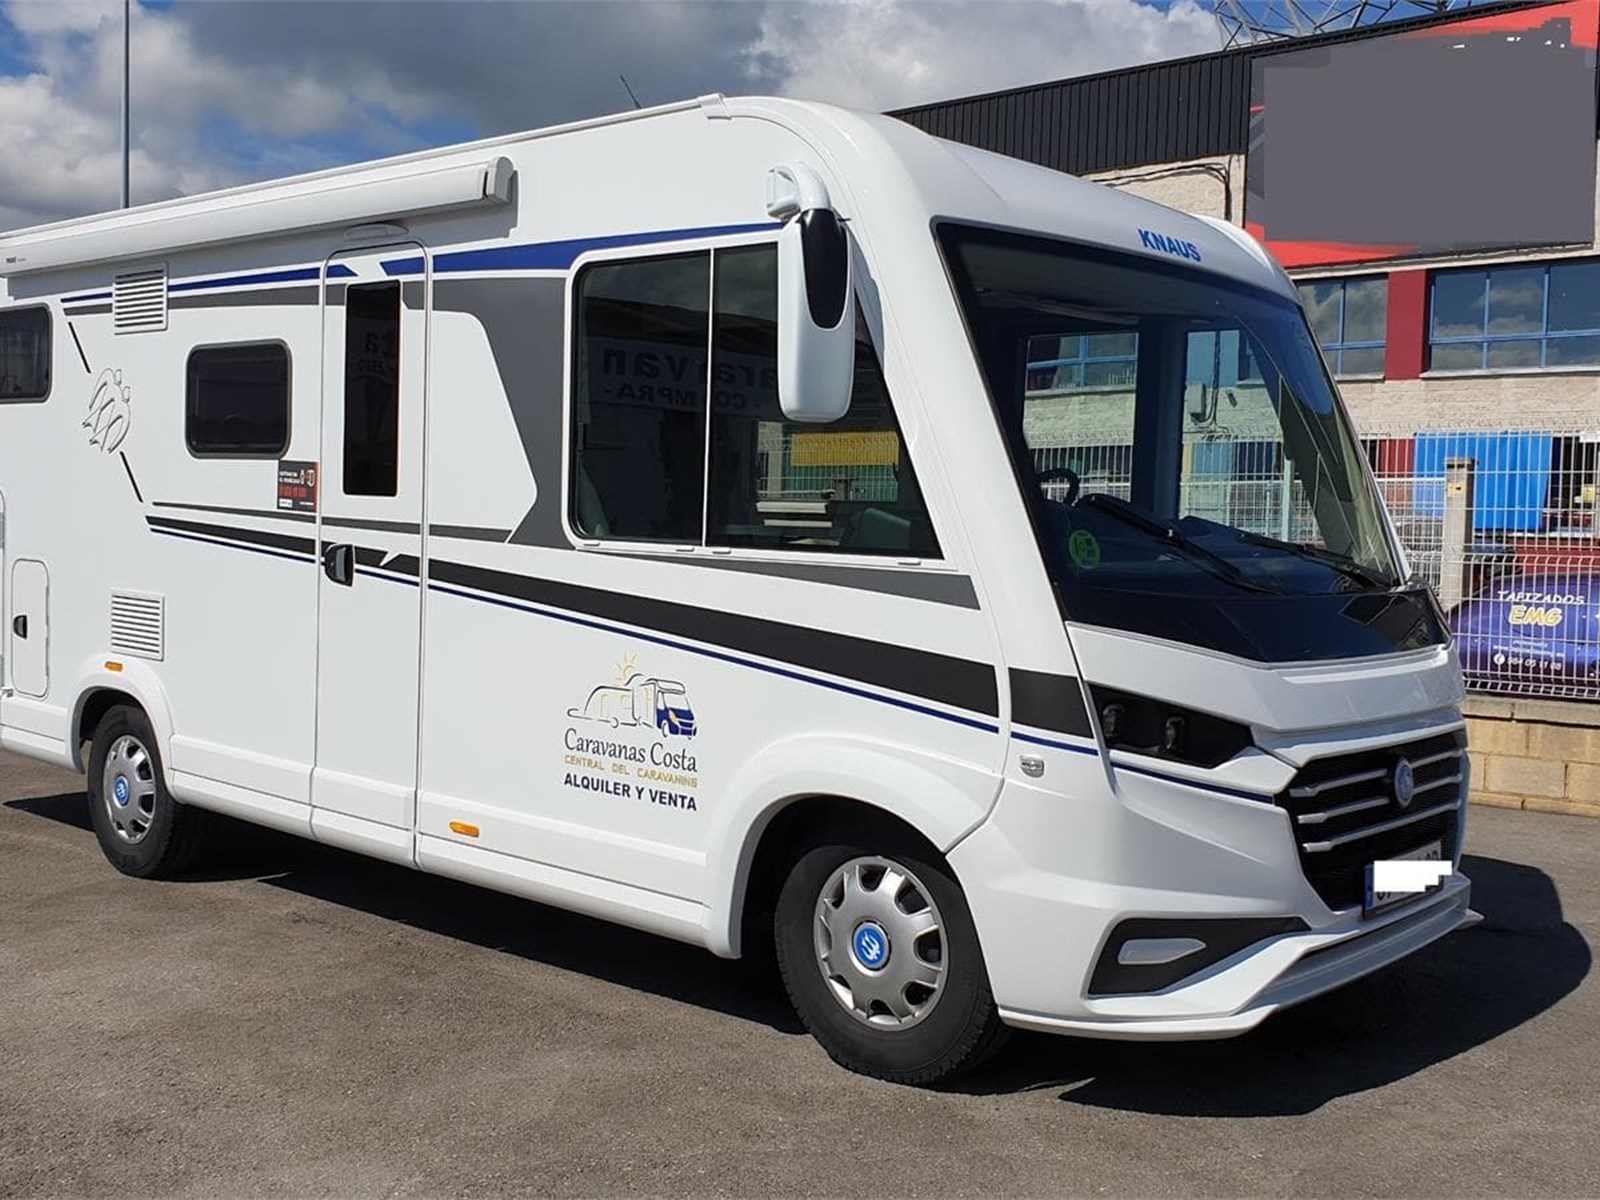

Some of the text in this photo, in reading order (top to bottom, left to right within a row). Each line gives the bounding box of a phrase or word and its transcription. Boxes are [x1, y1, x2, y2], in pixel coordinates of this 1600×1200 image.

[1137, 228, 1202, 262] KNAUS
[1497, 591, 1585, 605] TAPIZADOS
[1508, 604, 1563, 627] EMG
[564, 727, 698, 772] Caravanas Costa
[564, 754, 604, 771] CENTRAL
[612, 763, 630, 776] DEL
[564, 773, 697, 811] ALQUILER Y VENTA
